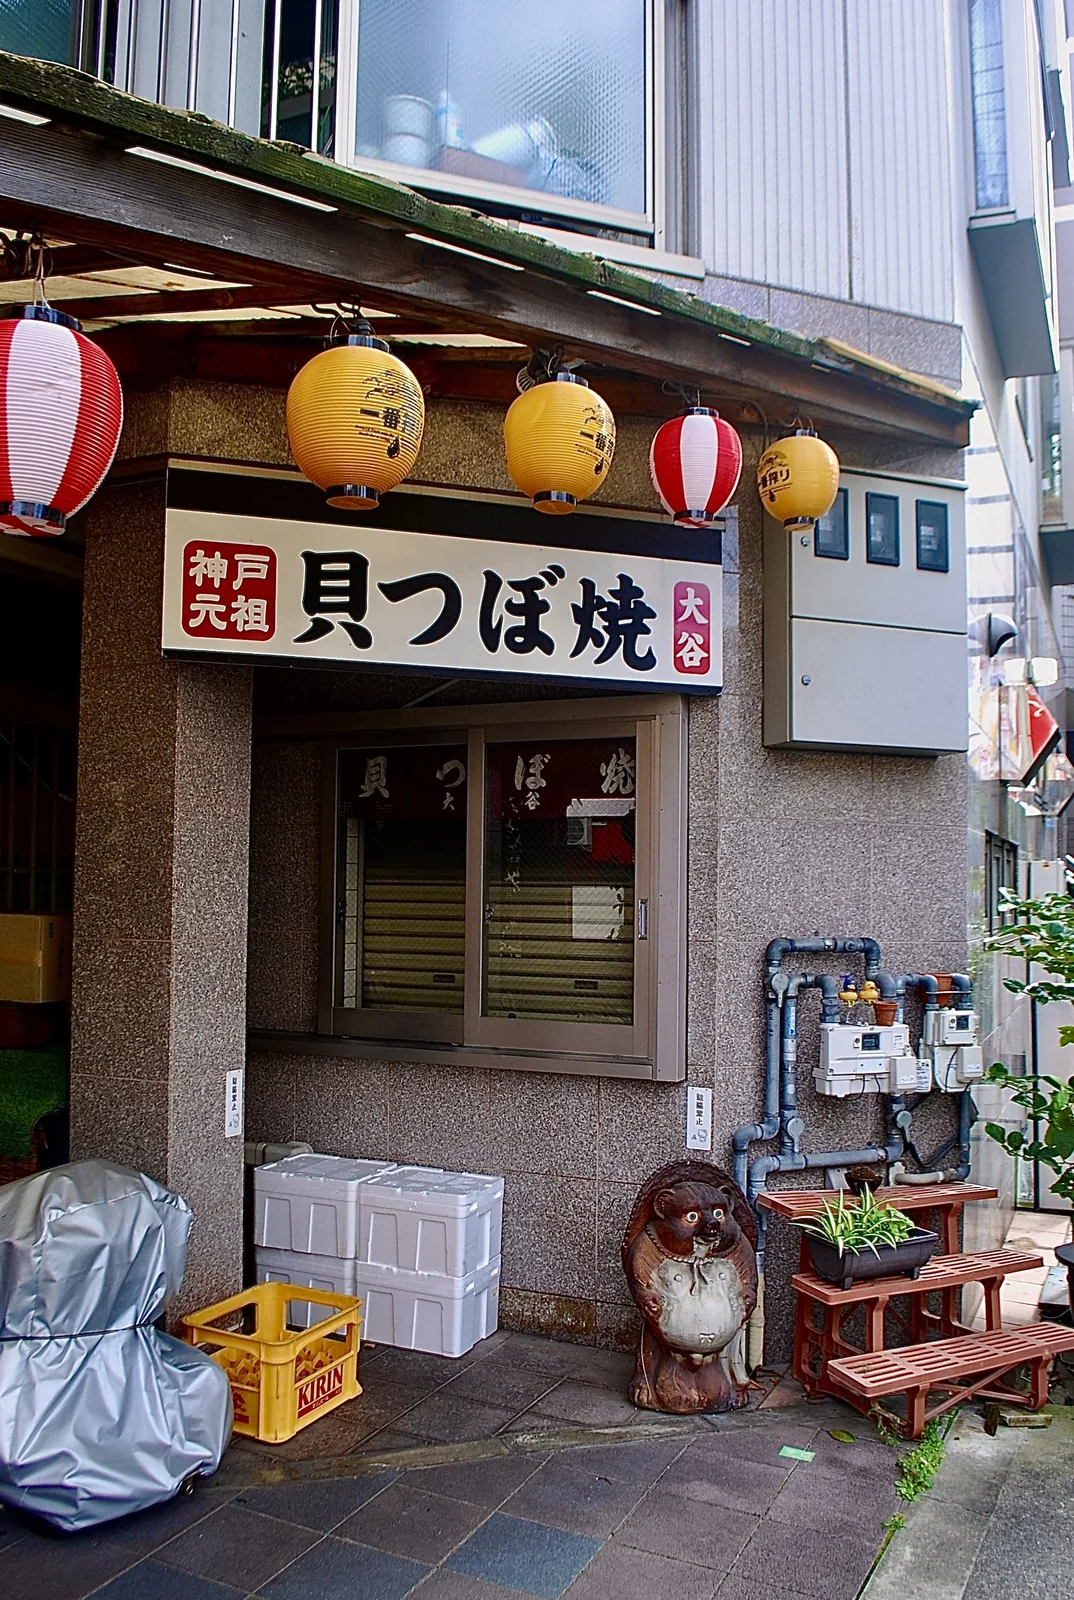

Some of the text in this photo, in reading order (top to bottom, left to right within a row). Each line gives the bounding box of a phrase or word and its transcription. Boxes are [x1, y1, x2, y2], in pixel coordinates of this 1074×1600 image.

[189, 549, 270, 590] 神戸
[188, 594, 270, 633] 元祖
[293, 550, 658, 671] 貝つぼ焼
[675, 587, 709, 668] 大谷
[298, 1363, 344, 1410] KIRIN
